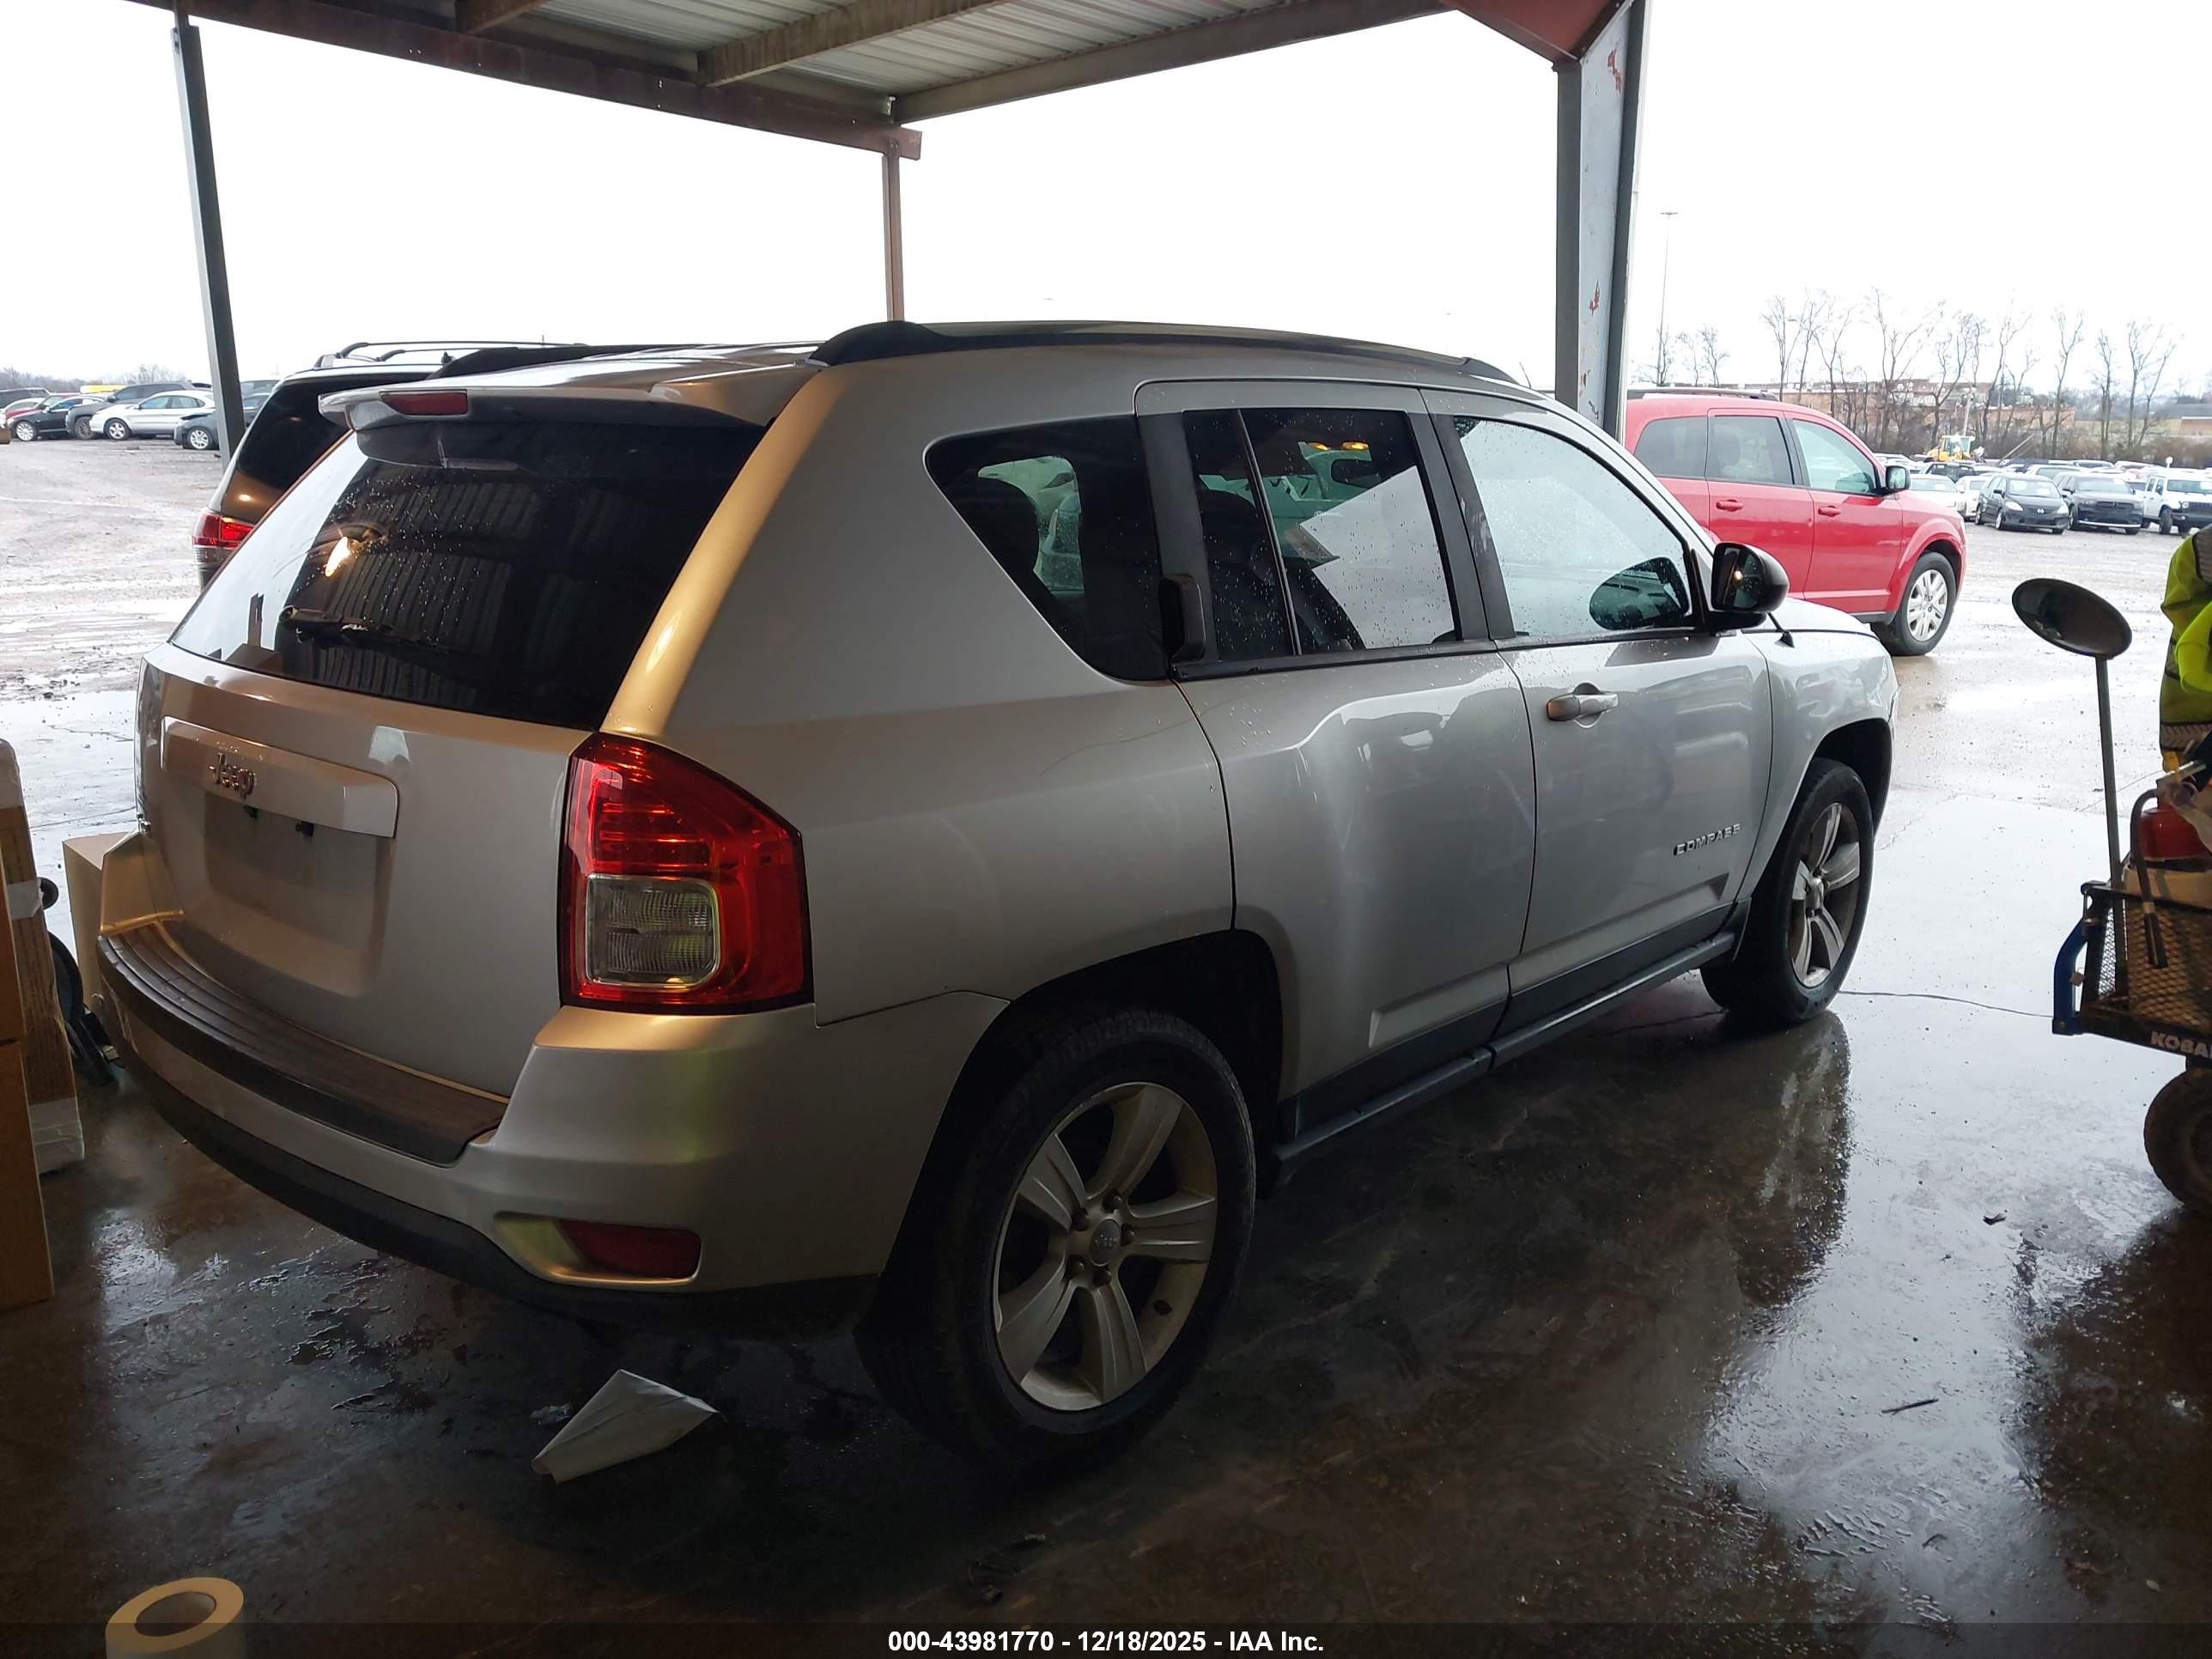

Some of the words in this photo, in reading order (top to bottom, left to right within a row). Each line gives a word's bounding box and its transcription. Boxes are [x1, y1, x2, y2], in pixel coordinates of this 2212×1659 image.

[209, 752, 257, 799] Jeep
[1674, 823, 1741, 856] COMPASS
[2150, 1030, 2212, 1059] KOBA
